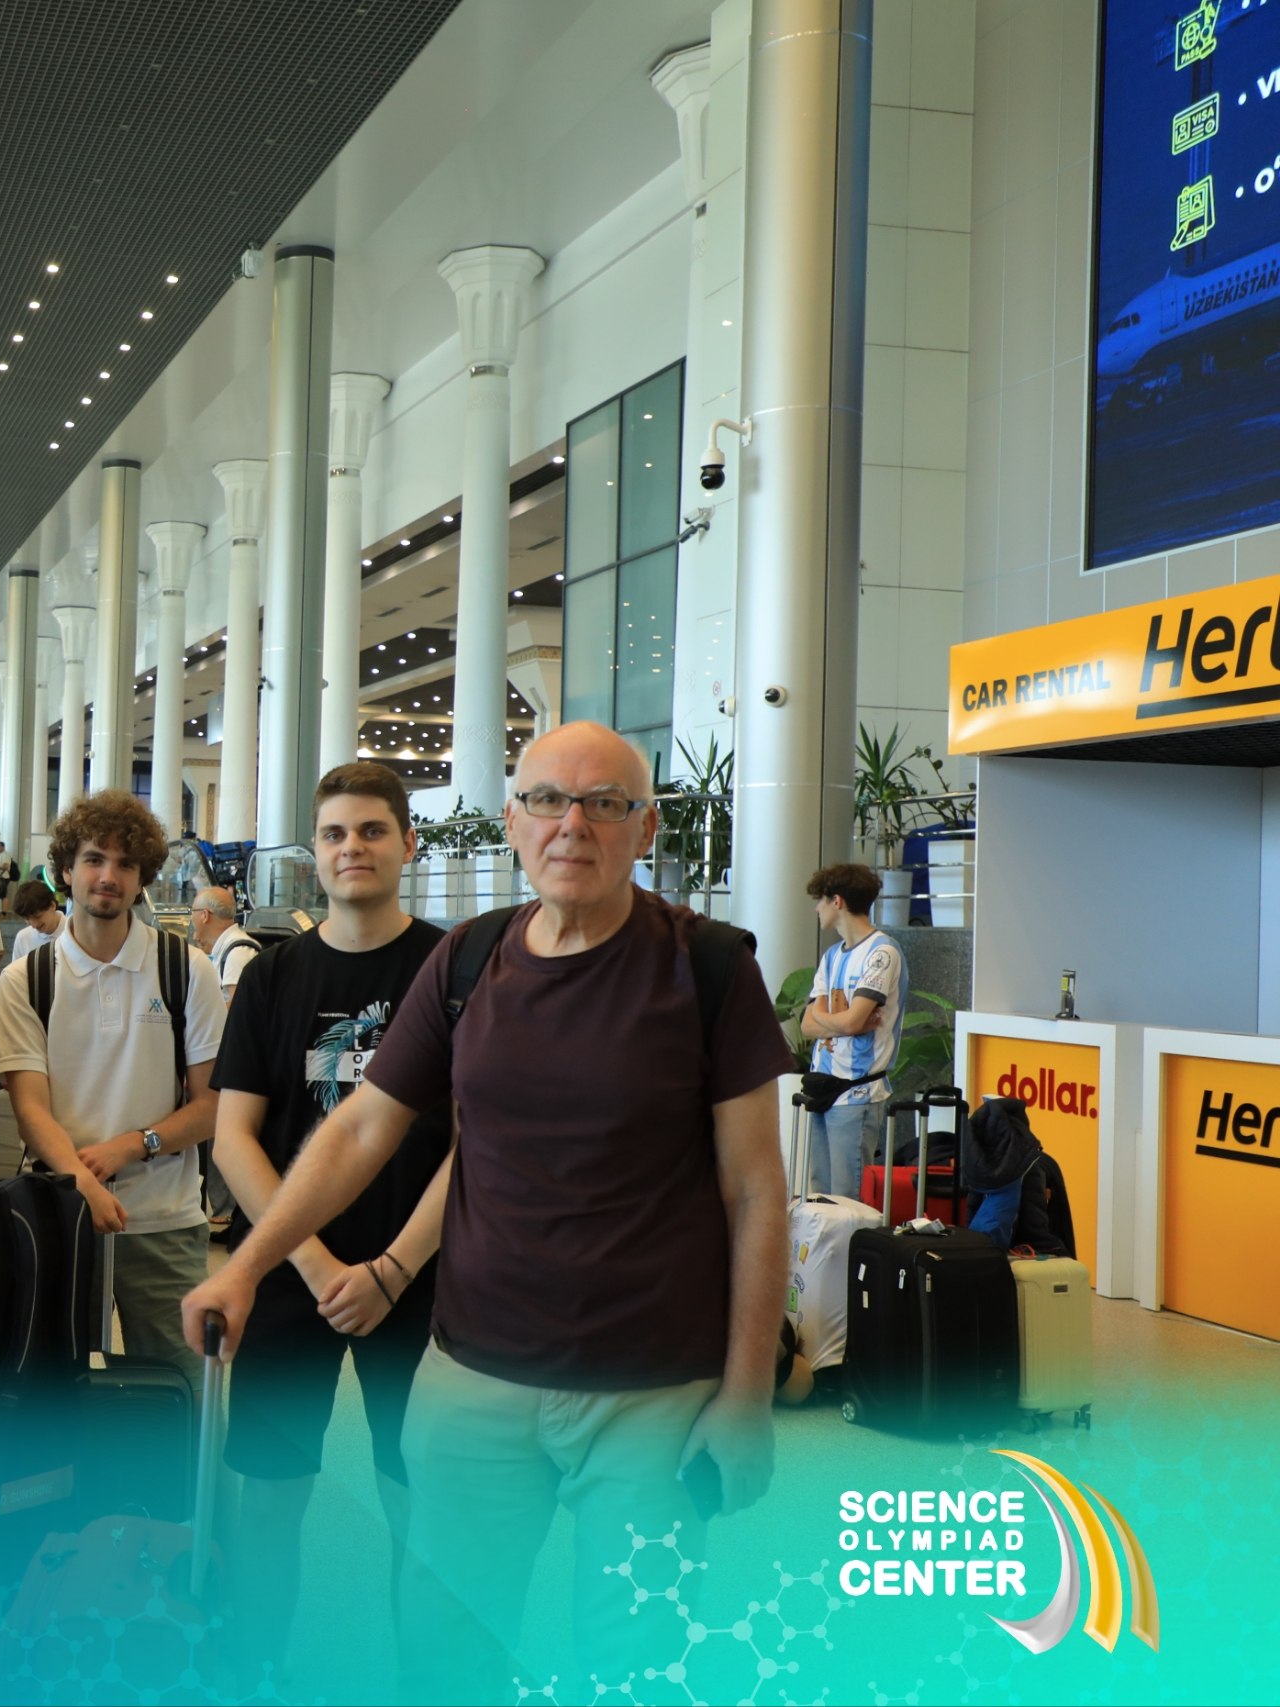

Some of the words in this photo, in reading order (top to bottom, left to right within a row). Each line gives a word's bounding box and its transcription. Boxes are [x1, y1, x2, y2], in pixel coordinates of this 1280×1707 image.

[1192, 106, 1215, 126] VISA
[1184, 266, 1280, 321] UZBEKISTAN
[962, 678, 1008, 712] CAR
[1015, 660, 1111, 704] RENTAL
[997, 1064, 1098, 1119] dollar.
